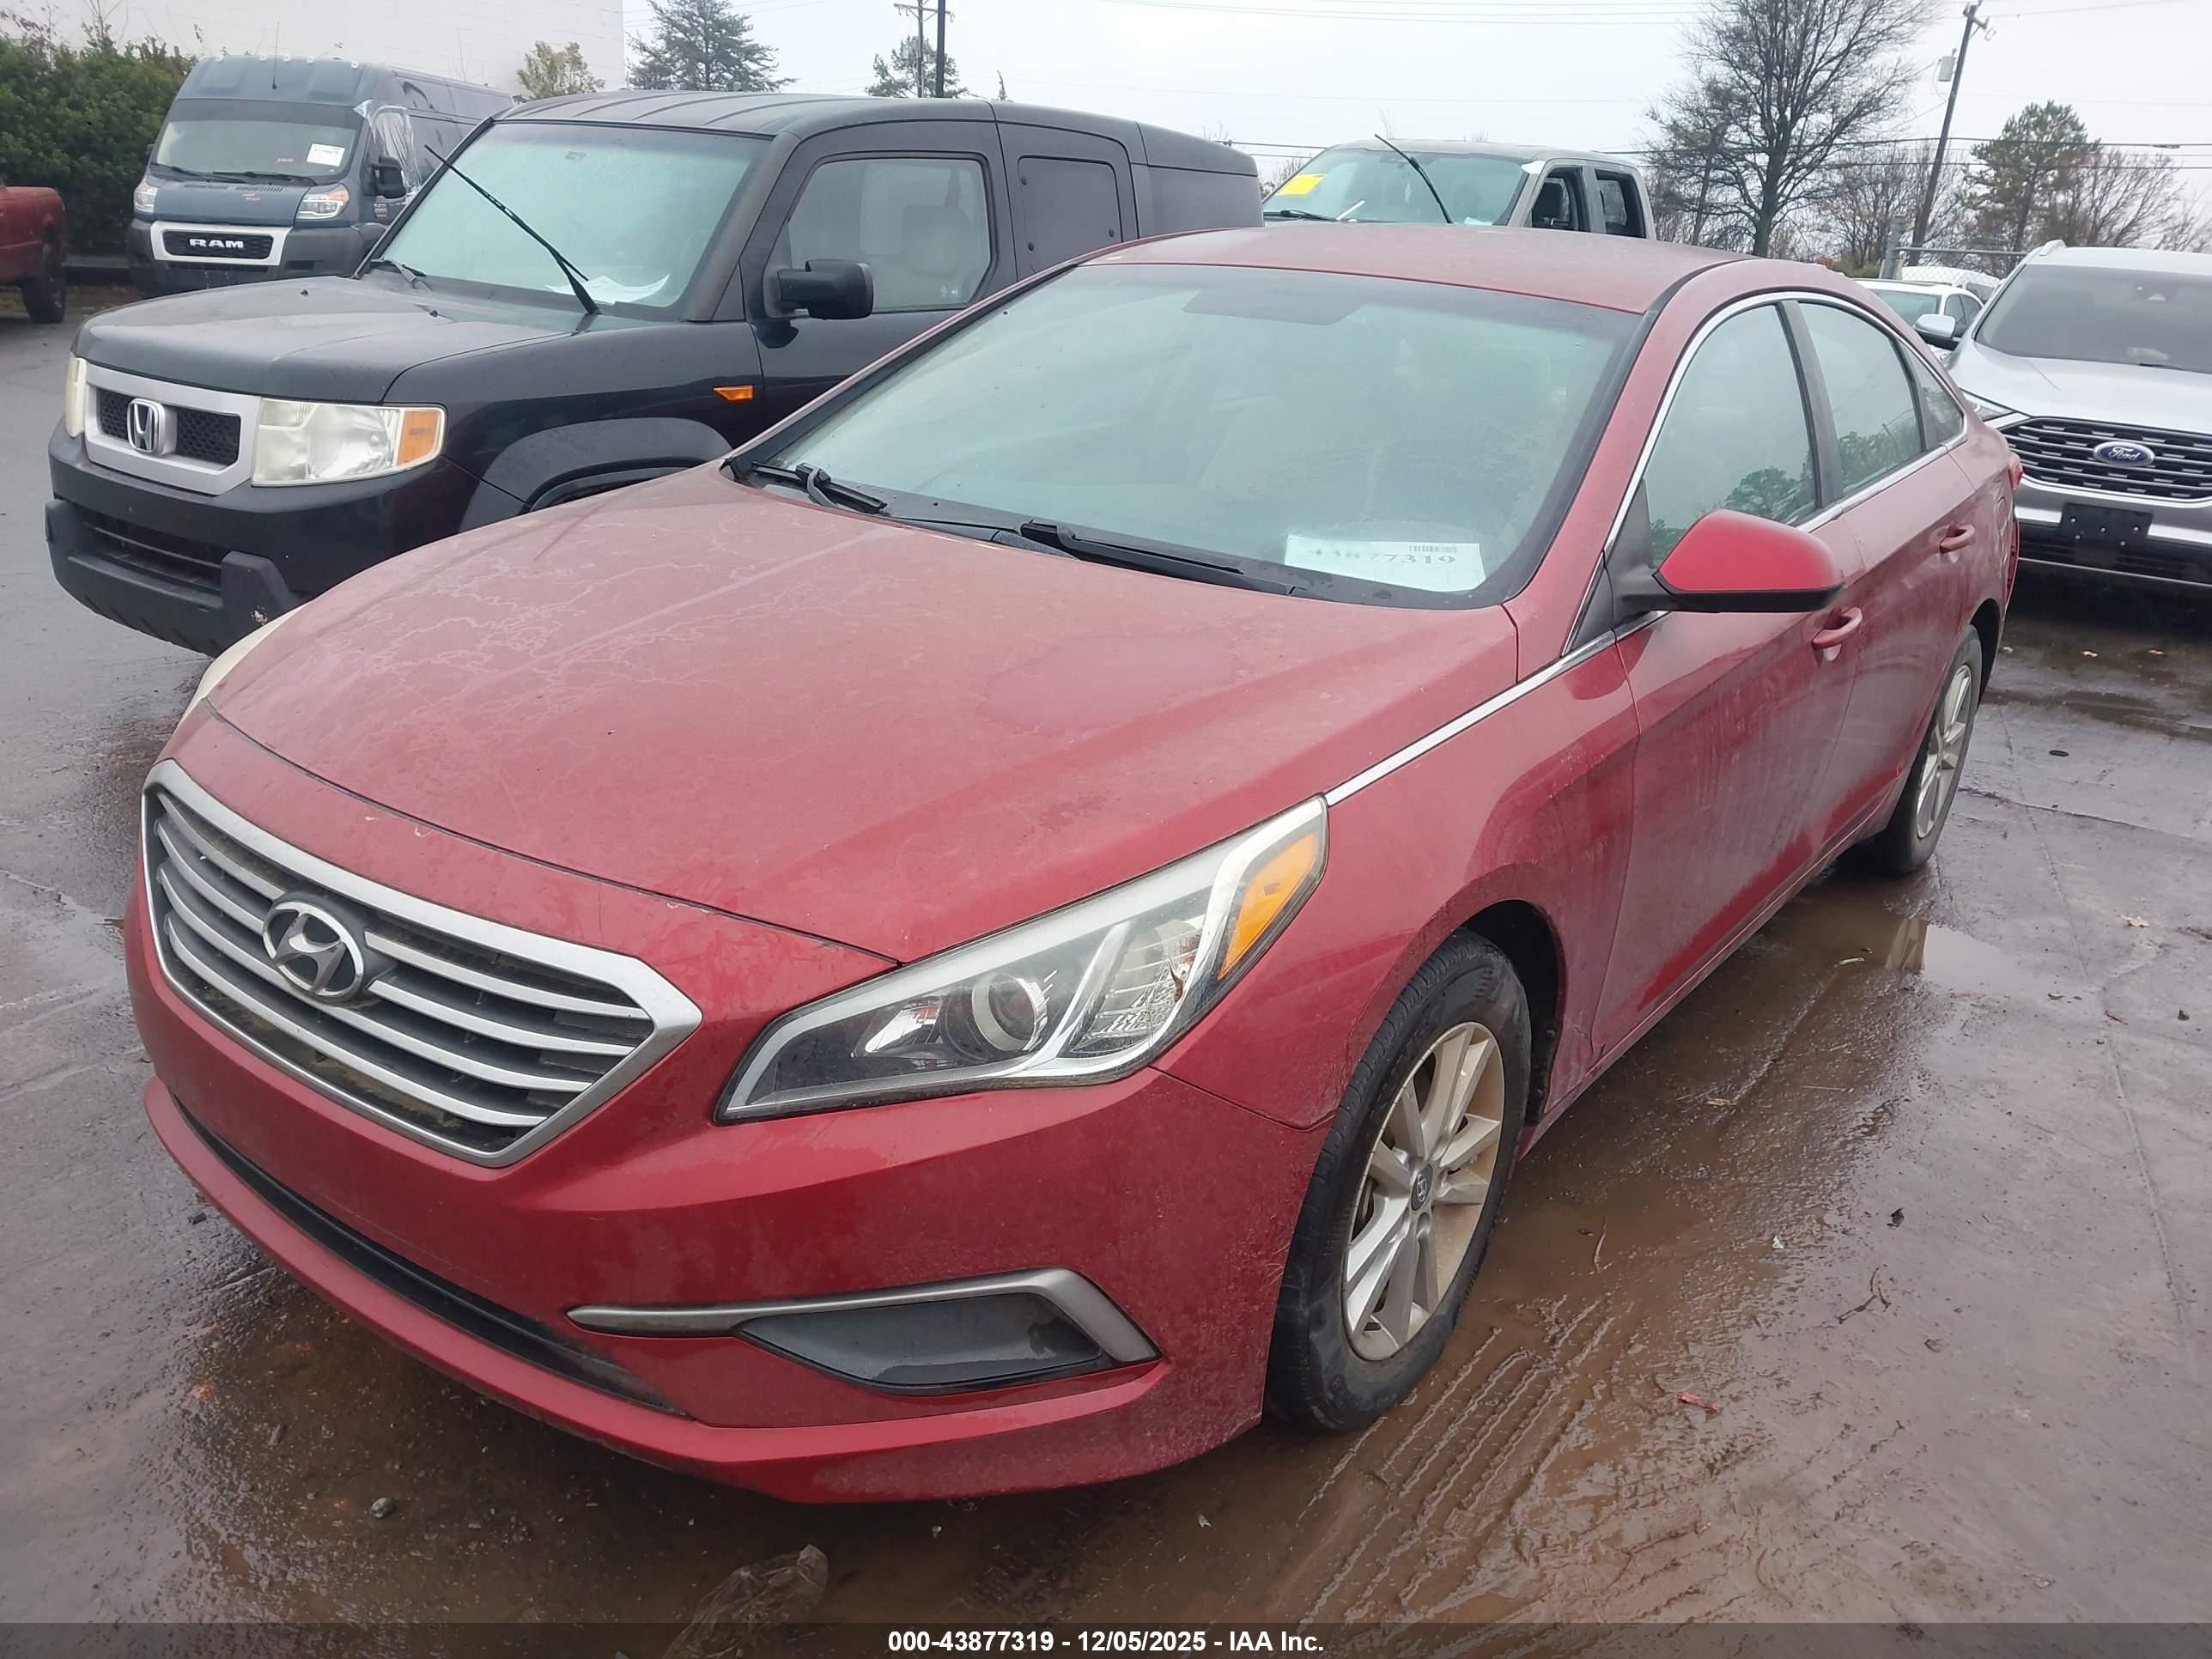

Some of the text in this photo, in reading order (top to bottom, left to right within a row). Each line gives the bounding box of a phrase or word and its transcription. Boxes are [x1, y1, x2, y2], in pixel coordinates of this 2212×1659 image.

[189, 239, 244, 248] RAM
[2109, 447, 2141, 460] Ford
[1308, 549, 1456, 564] 77319
